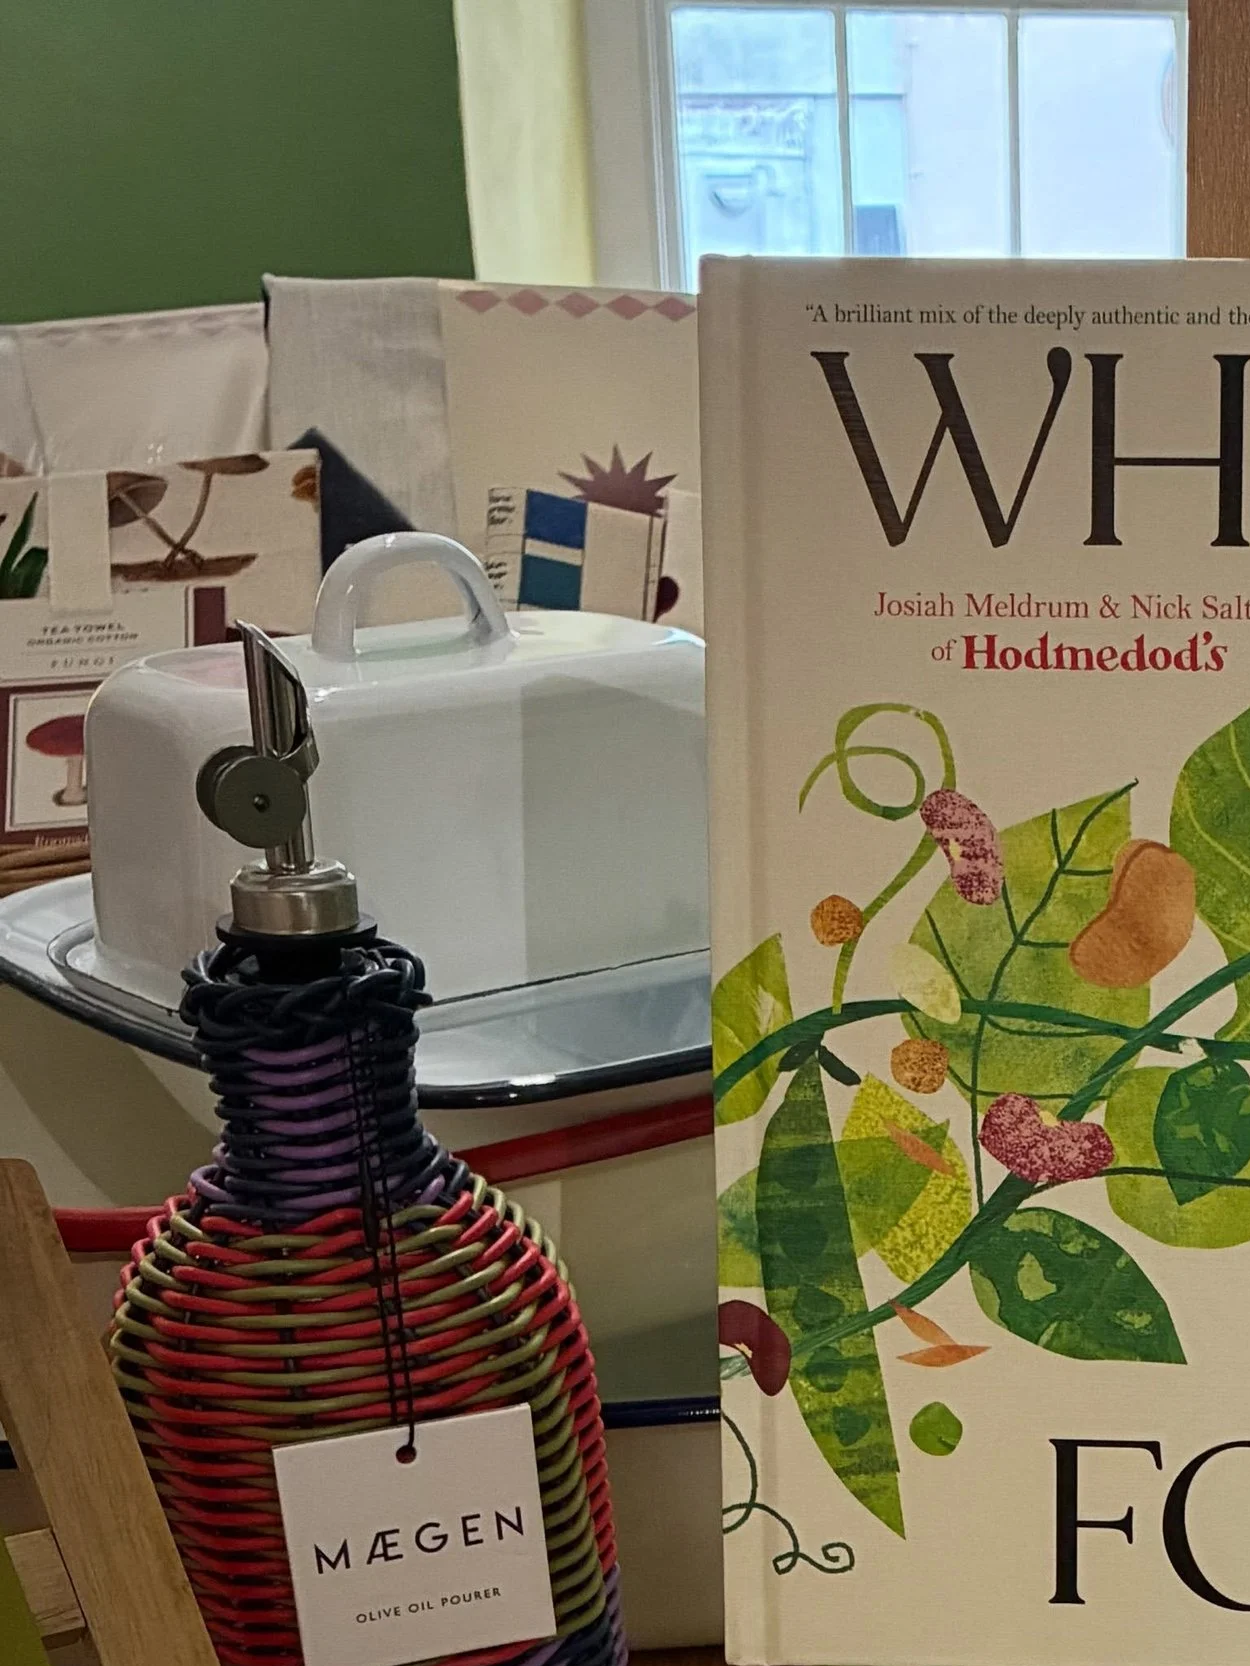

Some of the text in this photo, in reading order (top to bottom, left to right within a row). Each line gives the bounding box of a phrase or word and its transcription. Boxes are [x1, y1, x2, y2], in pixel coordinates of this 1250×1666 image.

[835, 304, 913, 324] brilliant
[919, 305, 956, 324] mix
[963, 305, 985, 325] of
[989, 304, 1018, 324] the
[1024, 305, 1086, 331] deeply
[1092, 305, 1180, 325] authentic
[1187, 306, 1220, 325] and
[874, 591, 954, 618] Josiah
[965, 592, 1089, 619] Meldrum
[1099, 594, 1121, 619] &
[1131, 594, 1193, 620] Nick
[27, 632, 139, 647] ORGANIC COTTON
[43, 622, 124, 636] TEA TOWEL
[931, 638, 957, 661] of
[313, 1505, 525, 1575] MÆGEN
[355, 1587, 501, 1624] OLIVE OIL POURER
